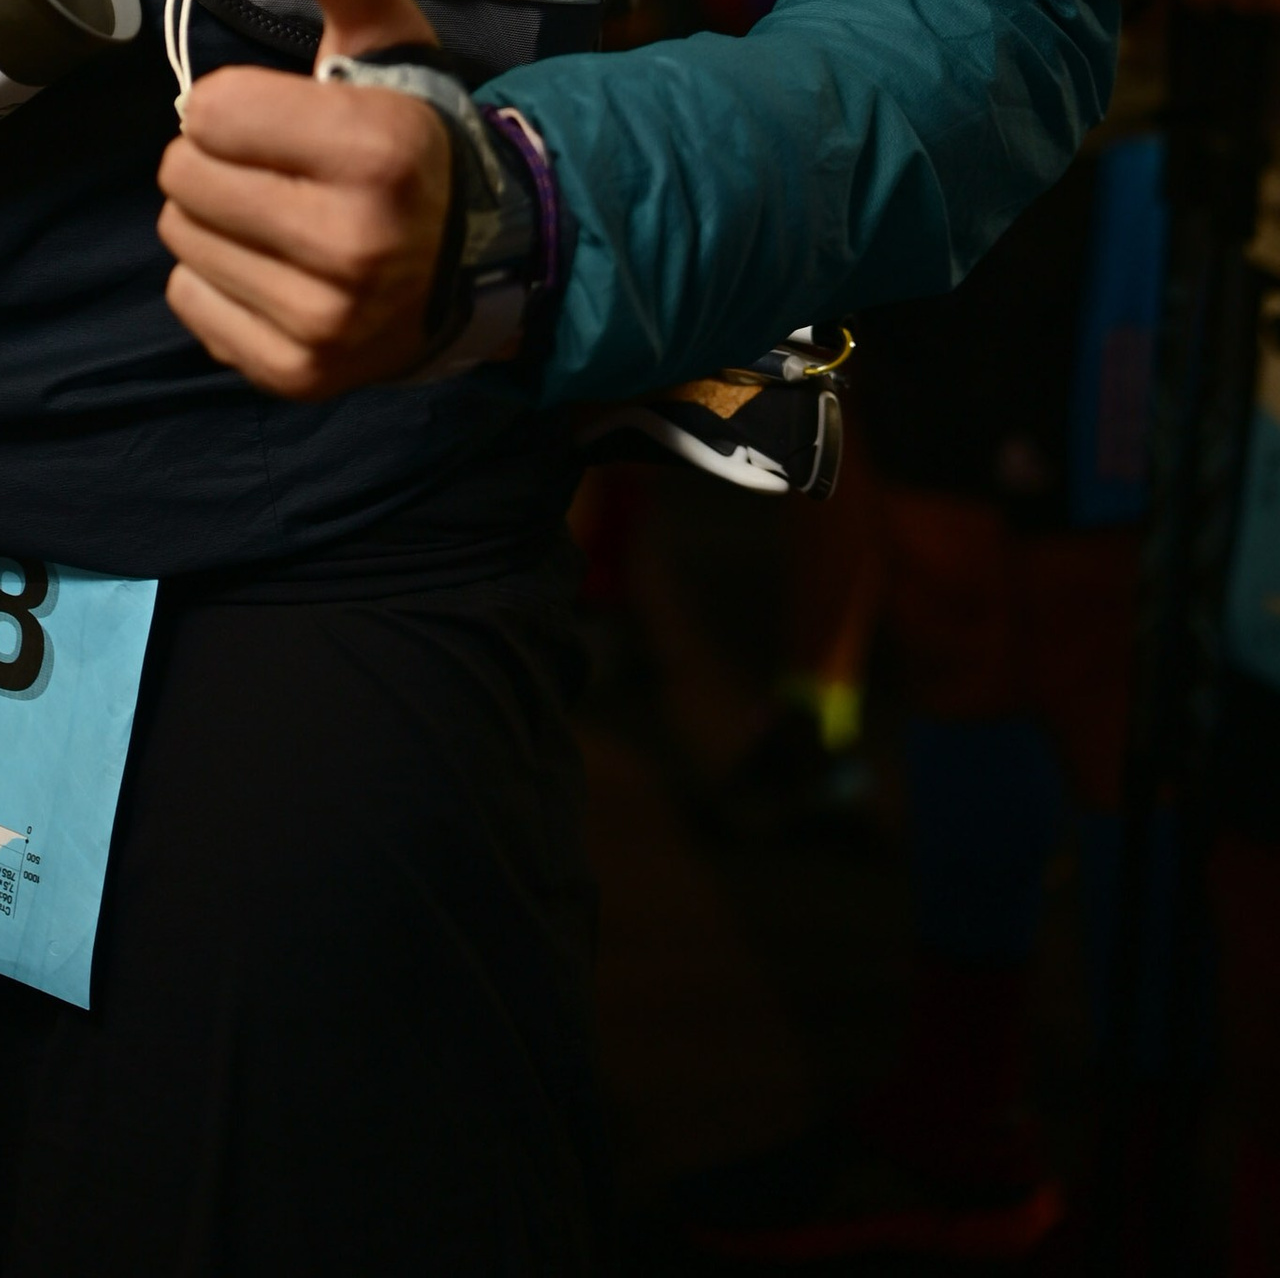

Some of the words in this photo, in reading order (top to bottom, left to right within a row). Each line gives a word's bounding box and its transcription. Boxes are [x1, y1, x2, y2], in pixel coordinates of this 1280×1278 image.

[26, 853, 40, 865] 500
[2, 868, 16, 881] 785
[23, 871, 40, 884] 1000
[3, 881, 14, 893] 7,5
